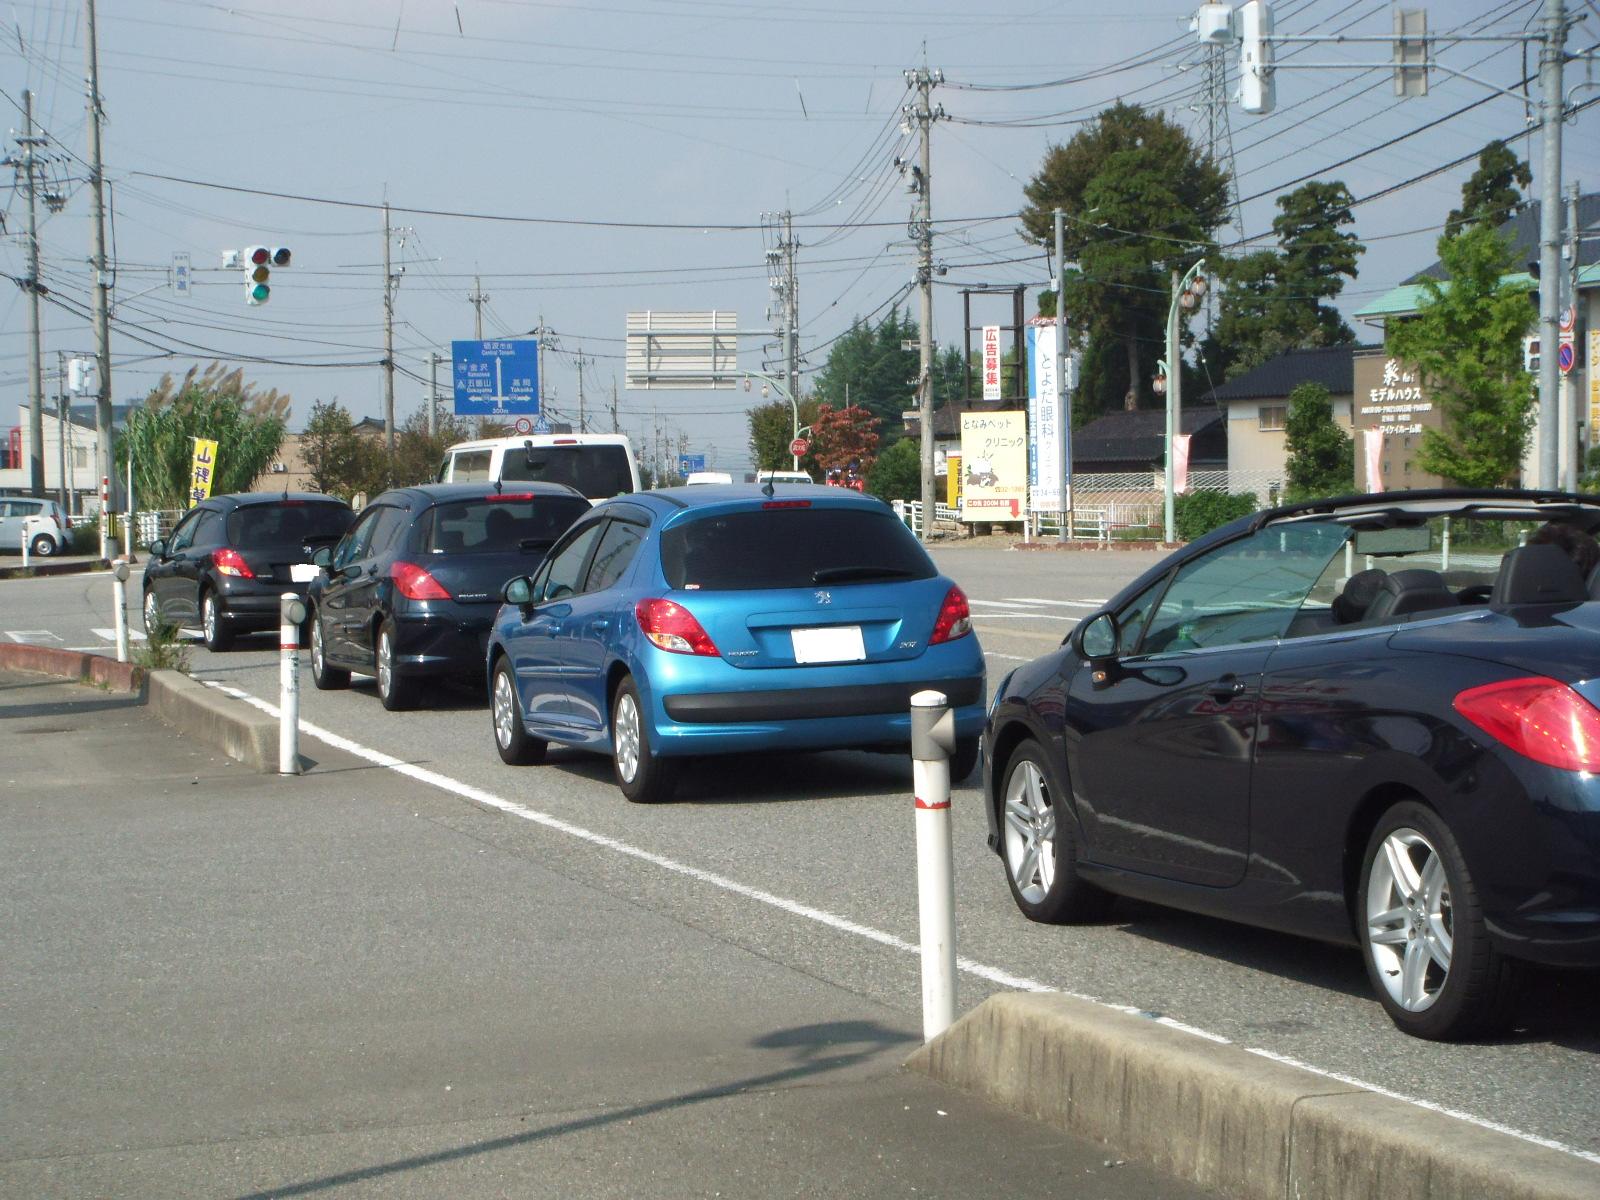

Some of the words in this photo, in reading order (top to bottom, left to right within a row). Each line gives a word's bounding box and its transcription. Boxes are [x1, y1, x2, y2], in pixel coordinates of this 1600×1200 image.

[985, 328, 998, 385] 広告募集
[1370, 387, 1421, 402] モデルハウス
[963, 419, 1011, 430] となみペット
[985, 437, 1024, 448] クリニック
